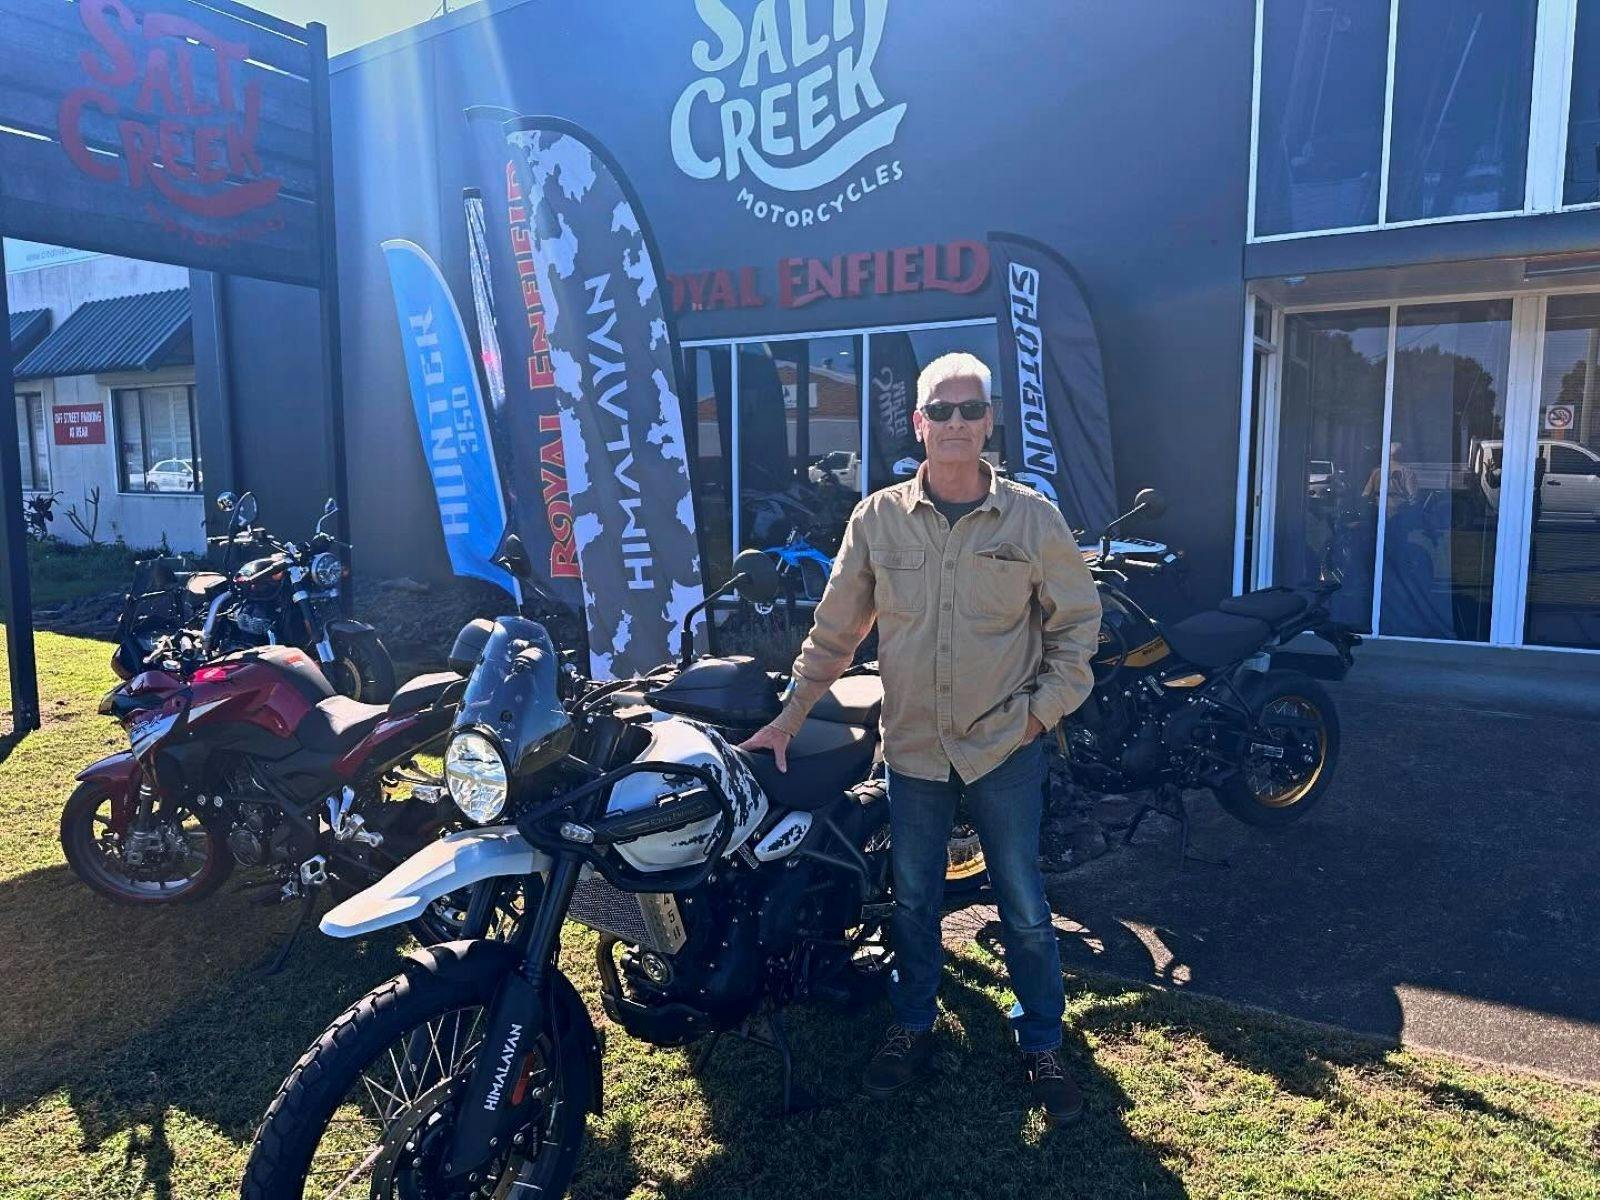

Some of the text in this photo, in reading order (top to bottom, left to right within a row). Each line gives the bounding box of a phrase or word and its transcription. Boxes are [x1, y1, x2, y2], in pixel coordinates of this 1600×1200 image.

[79, 0, 250, 116] SALT
[671, 15, 907, 191] CREEK
[58, 81, 284, 217] CREEK
[736, 160, 904, 228] MOTORCYCLES
[666, 240, 990, 312] YAL ENFIELD
[409, 303, 470, 536] HUNTER
[451, 384, 482, 455] 350
[1010, 264, 1056, 472] SHOTGUN
[584, 273, 655, 590] HIMALAYAN
[483, 1022, 523, 1112] HIMALAYAN
